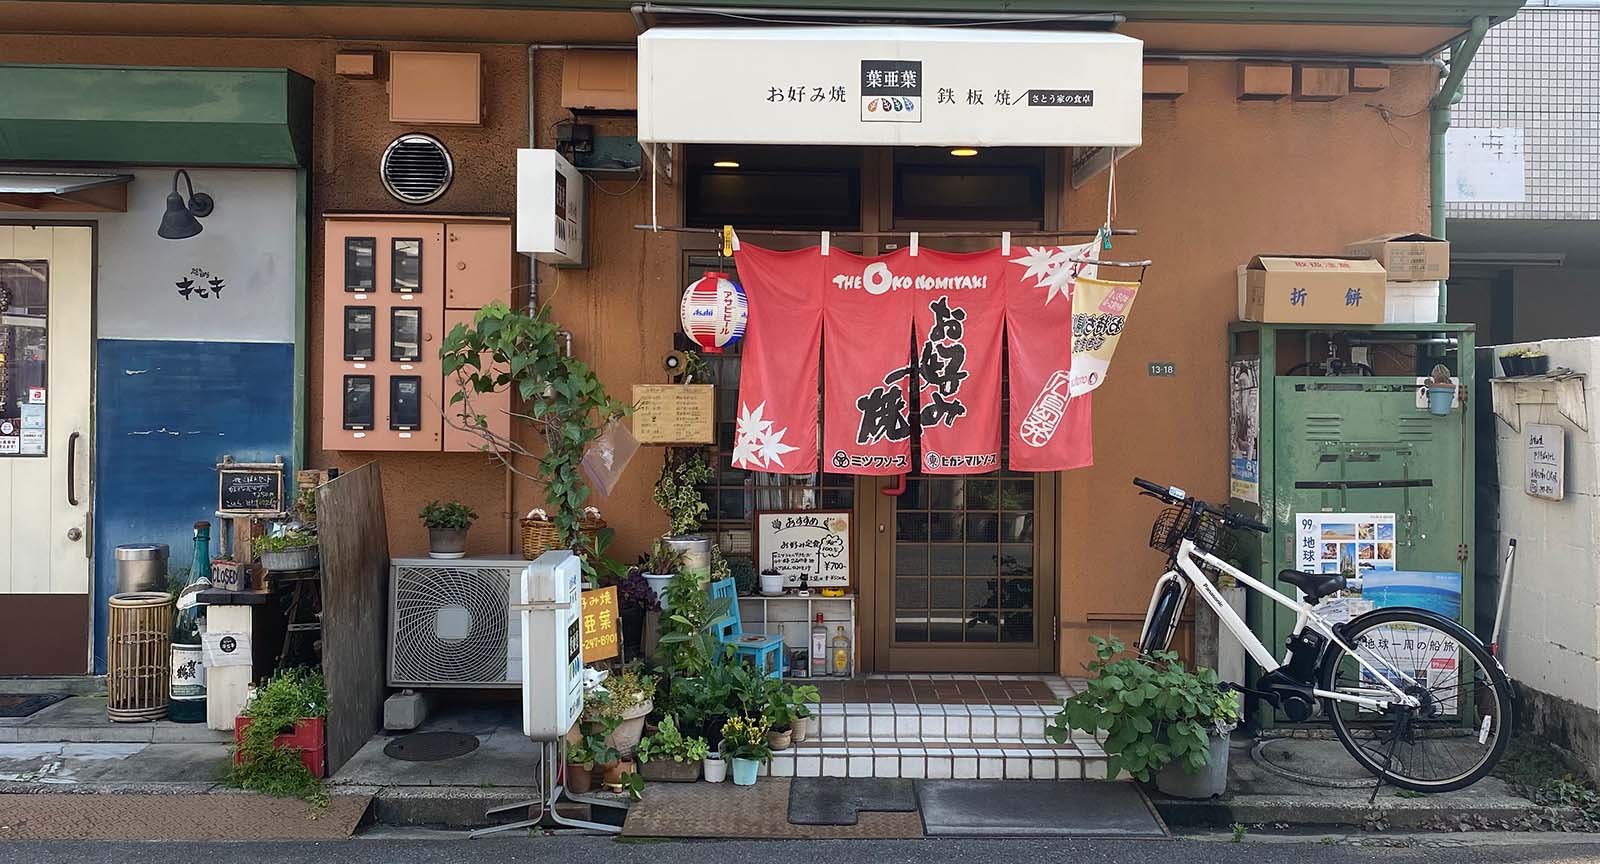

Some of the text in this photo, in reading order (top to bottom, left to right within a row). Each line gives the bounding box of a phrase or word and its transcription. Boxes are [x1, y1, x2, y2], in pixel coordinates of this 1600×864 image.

[865, 69, 917, 88] 葉亜葉
[766, 86, 1091, 106] お好み焼 鉄板焼 さとう家の食卓
[832, 273, 862, 290] THE
[692, 308, 714, 317] Asahi
[719, 290, 733, 335] アサヒビール
[1151, 365, 1174, 374] 13-18
[851, 454, 908, 468] ミツワソース
[941, 453, 997, 468] ヒガシマルソース
[785, 516, 819, 528] おすすめ
[212, 567, 238, 585] CLOSED
[1365, 638, 1455, 652] 地球一周の船旅
